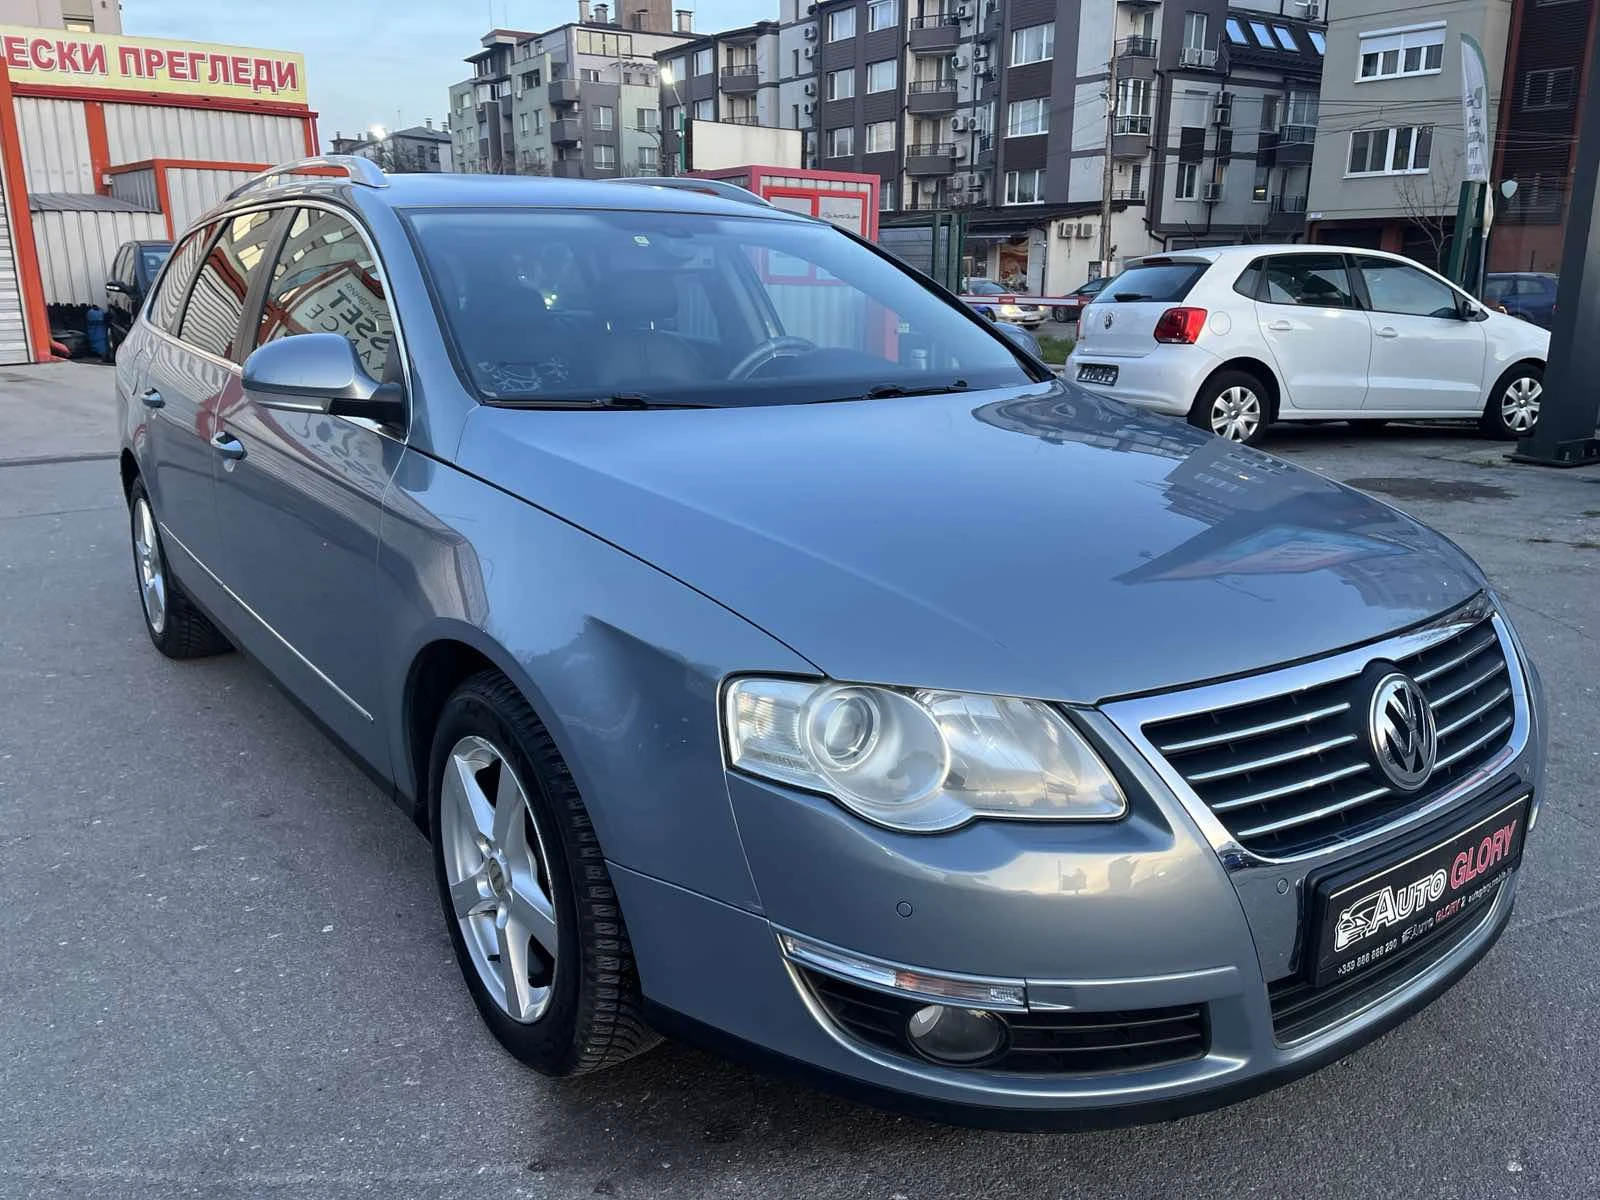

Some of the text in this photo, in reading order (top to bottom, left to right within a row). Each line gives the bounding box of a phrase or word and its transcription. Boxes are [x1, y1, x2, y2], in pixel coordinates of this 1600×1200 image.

[0, 34, 299, 95] ЕСКИ ПРЕГЛЕДИ
[1365, 819, 1518, 938] AUTO GLORY
